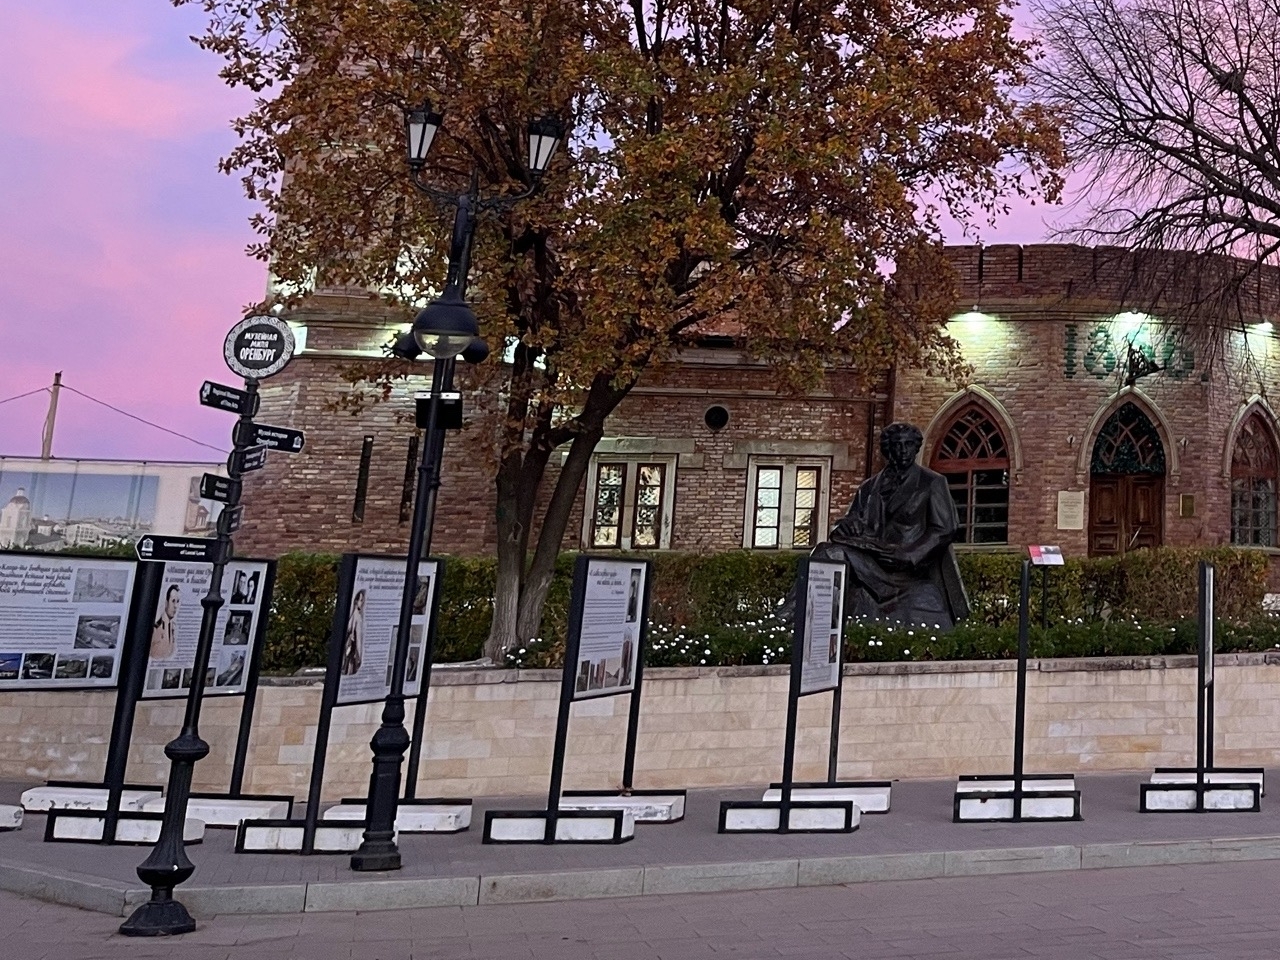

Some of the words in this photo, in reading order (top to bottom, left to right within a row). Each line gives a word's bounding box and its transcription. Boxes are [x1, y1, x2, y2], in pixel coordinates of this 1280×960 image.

[244, 332, 278, 341] МУЗЕЙНАЯ
[250, 340, 269, 348] МИЛЯ
[240, 347, 277, 361] ОРЕНБУРГ
